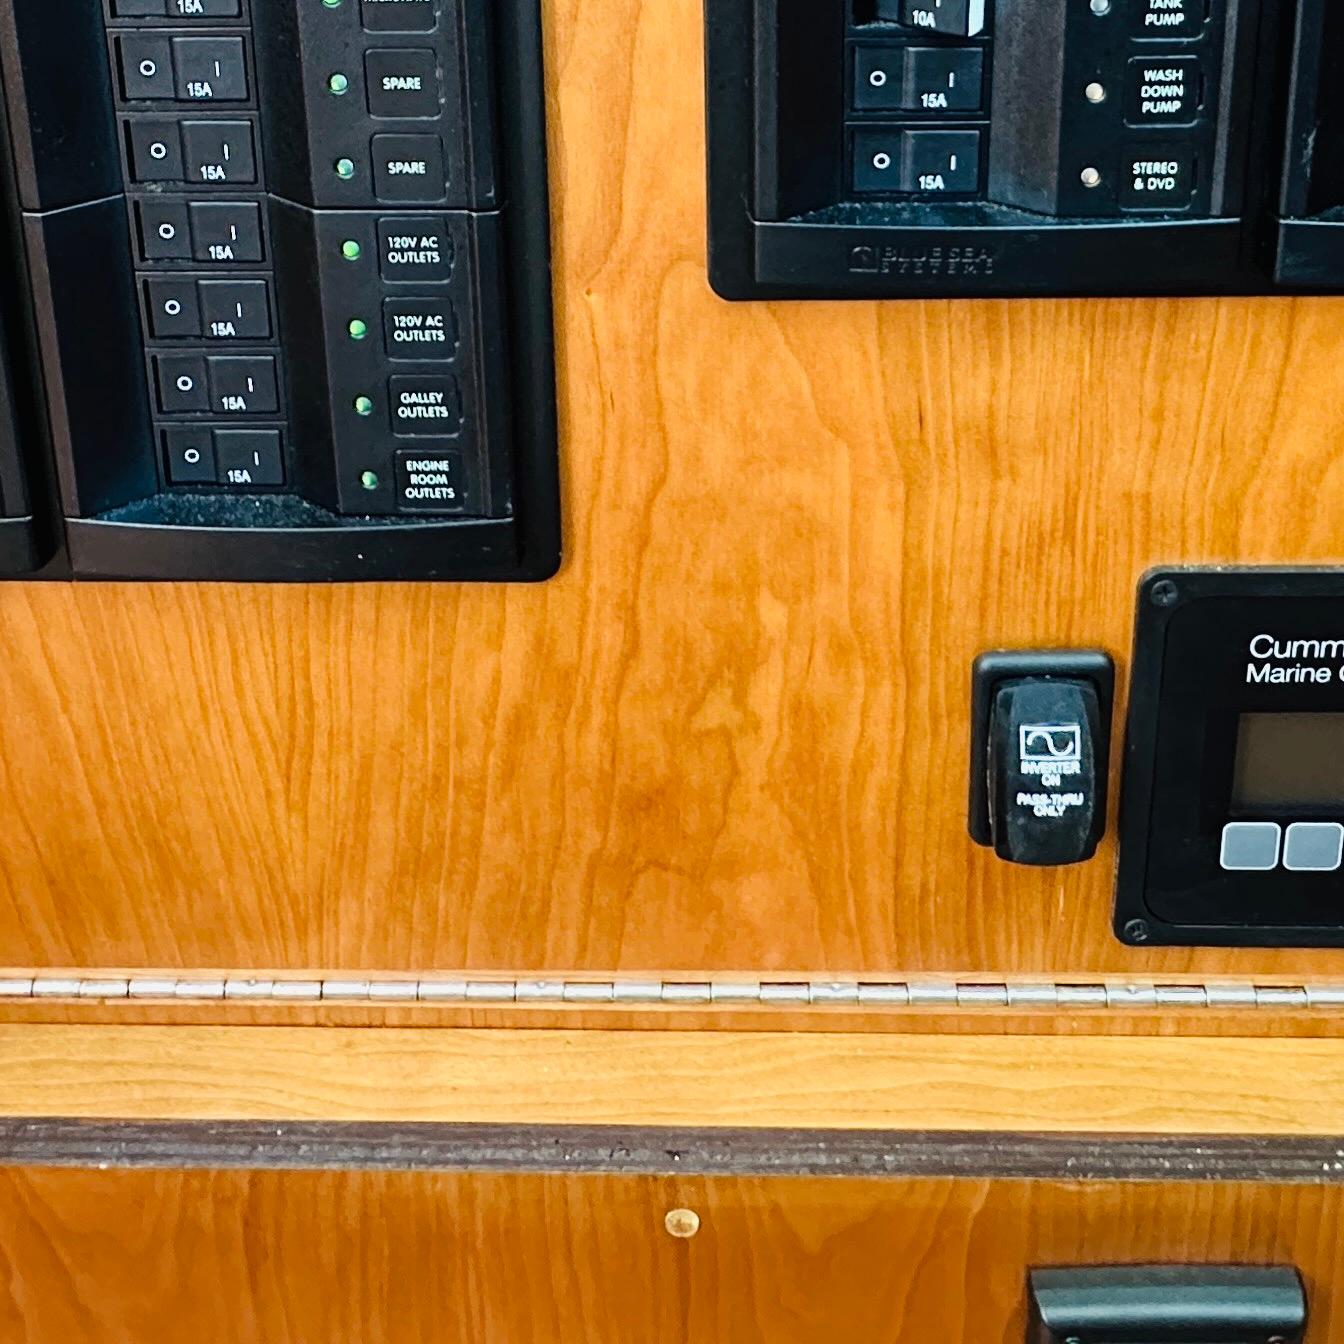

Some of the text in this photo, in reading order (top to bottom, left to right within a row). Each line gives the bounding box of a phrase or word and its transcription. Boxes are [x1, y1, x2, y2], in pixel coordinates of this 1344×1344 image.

[1145, 13, 1185, 26] PUMP
[383, 77, 421, 91] SPARE
[1132, 162, 1177, 175] STEREO
[1147, 178, 1175, 190] DVD
[388, 236, 438, 249] 120V AC
[388, 250, 440, 264] OUTLETS
[400, 392, 443, 405] GALLEY
[397, 406, 448, 419] OUTLETS
[406, 460, 449, 473] ENGINE
[410, 473, 448, 486] ROOM
[405, 487, 455, 500] OUTLETS
[1245, 663, 1332, 683] Marine
